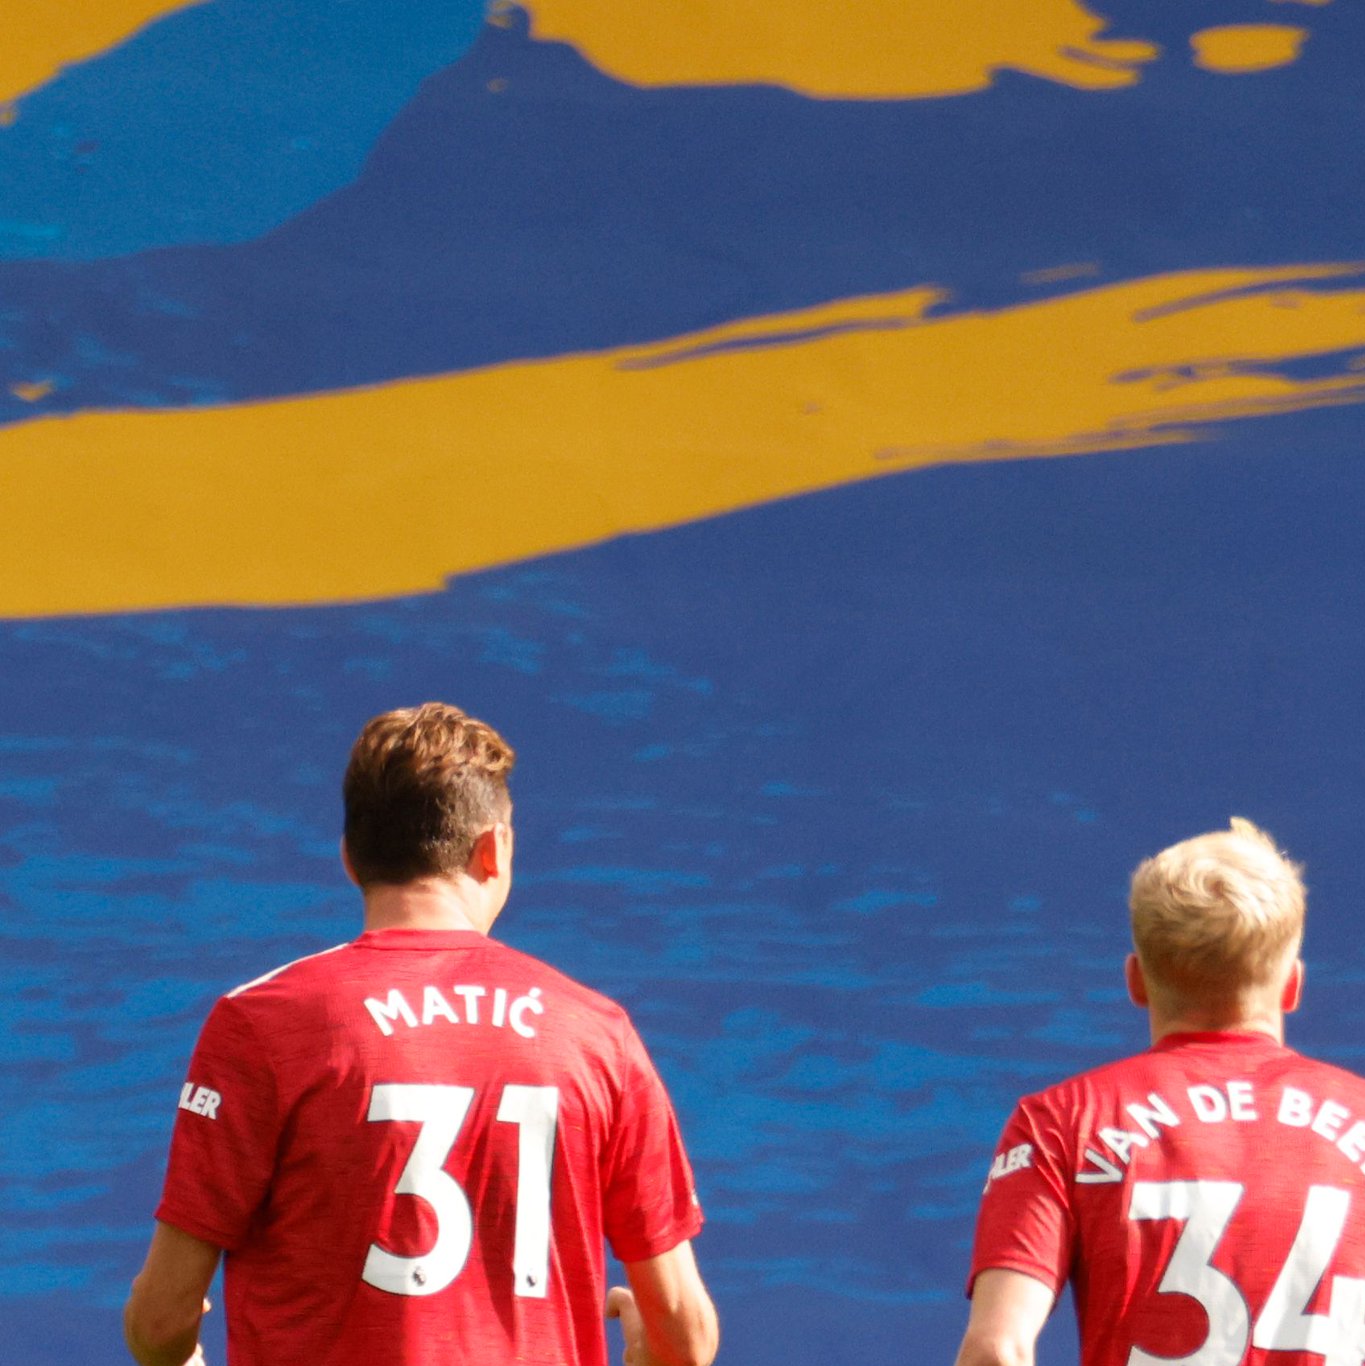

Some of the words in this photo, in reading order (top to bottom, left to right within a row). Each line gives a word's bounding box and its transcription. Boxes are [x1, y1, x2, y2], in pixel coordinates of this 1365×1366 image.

[363, 986, 544, 1038] MATIĆ
[1075, 1092, 1181, 1185] VAN
[1186, 1080, 1258, 1124] DE
[362, 1083, 559, 1298] 31
